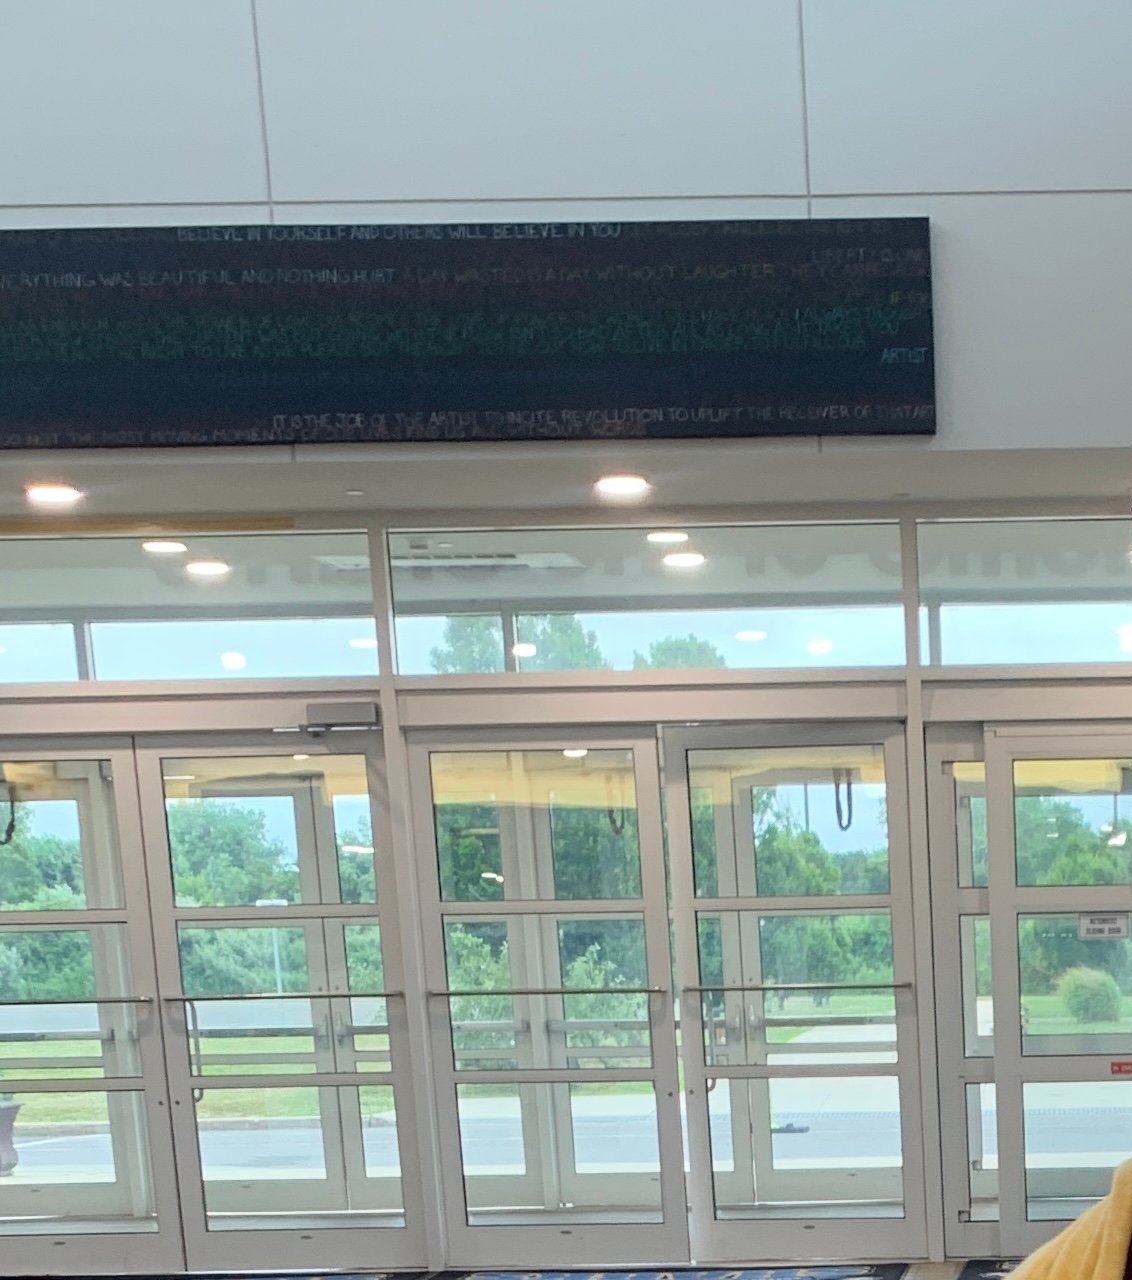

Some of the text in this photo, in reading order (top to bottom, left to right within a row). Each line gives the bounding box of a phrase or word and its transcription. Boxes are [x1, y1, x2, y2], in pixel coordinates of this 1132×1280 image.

[177, 226, 243, 241] BELIEVE
[247, 226, 261, 241] IN
[268, 226, 347, 241] YOURSELF
[351, 225, 380, 240] AND
[383, 225, 443, 240] OTHERS
[449, 224, 487, 239] WILL
[493, 224, 564, 239] BELIEVE
[568, 223, 584, 238] IN
[590, 223, 622, 238] YOU
[99, 270, 134, 288] WAS
[139, 269, 237, 287] BEAUTIFUL
